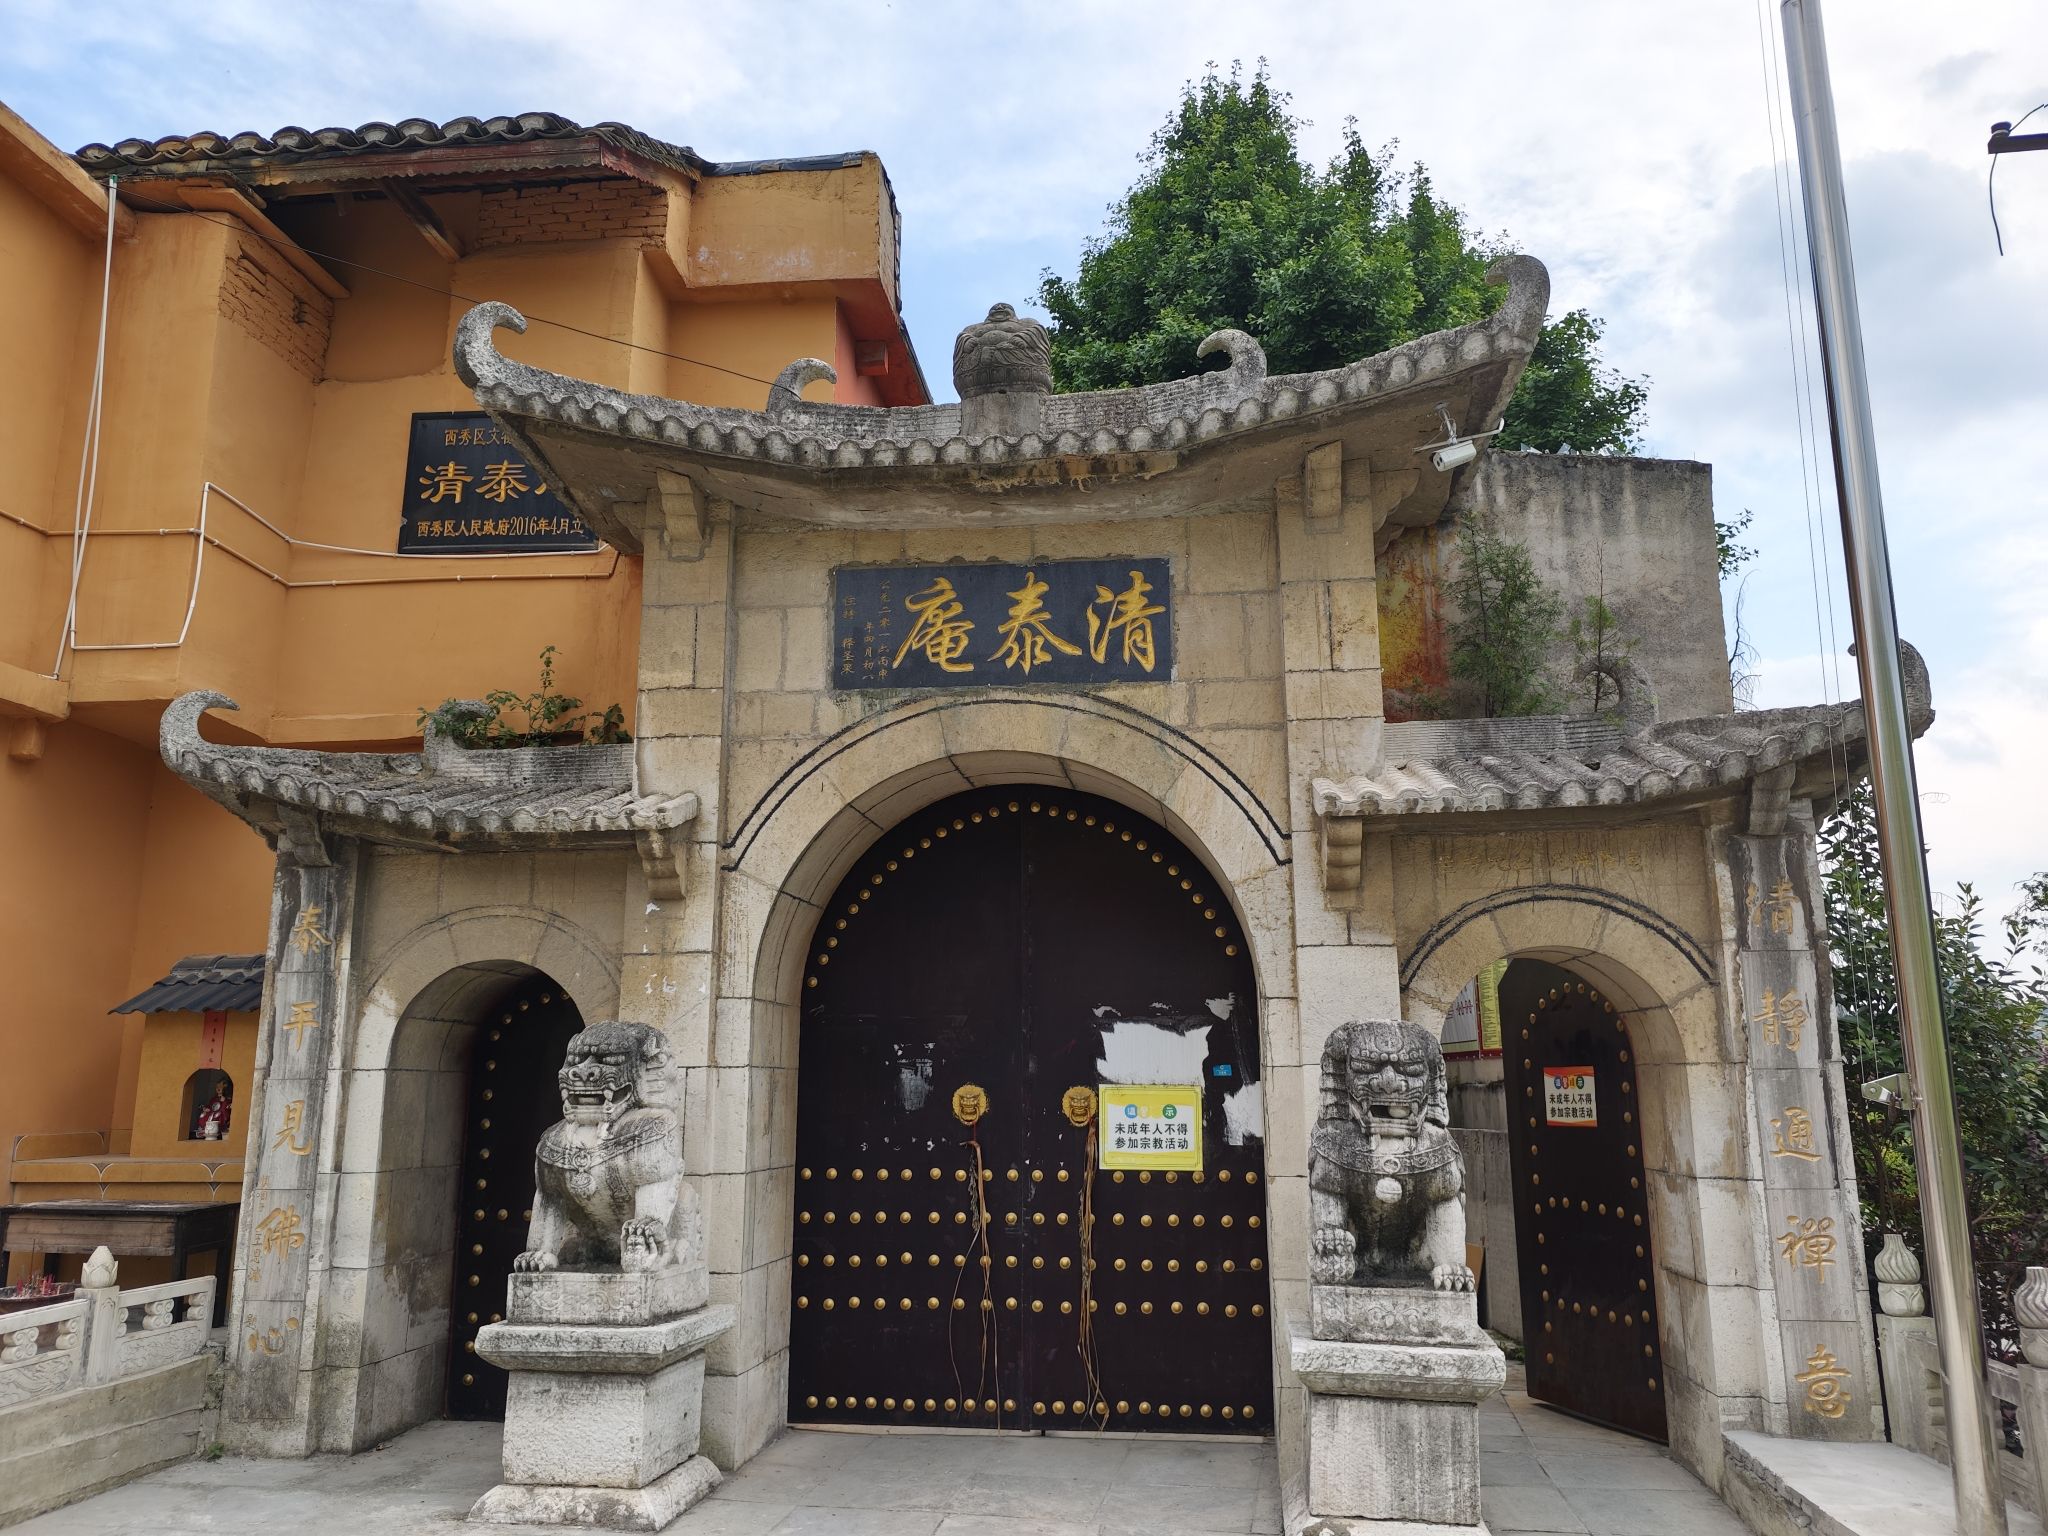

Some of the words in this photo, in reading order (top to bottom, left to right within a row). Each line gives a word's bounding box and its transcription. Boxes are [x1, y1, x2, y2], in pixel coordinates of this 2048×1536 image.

[418, 459, 547, 504] 清泰
[417, 515, 584, 537] 西秀区人民政府2016年4月立
[892, 570, 1166, 677] 清泰庵
[1549, 1092, 1592, 1105] 未成年人不得
[1550, 1106, 1593, 1118] 参加宗教活动
[1115, 1122, 1188, 1135] 未成年人不得
[1114, 1136, 1189, 1149] 参加宗教活动
